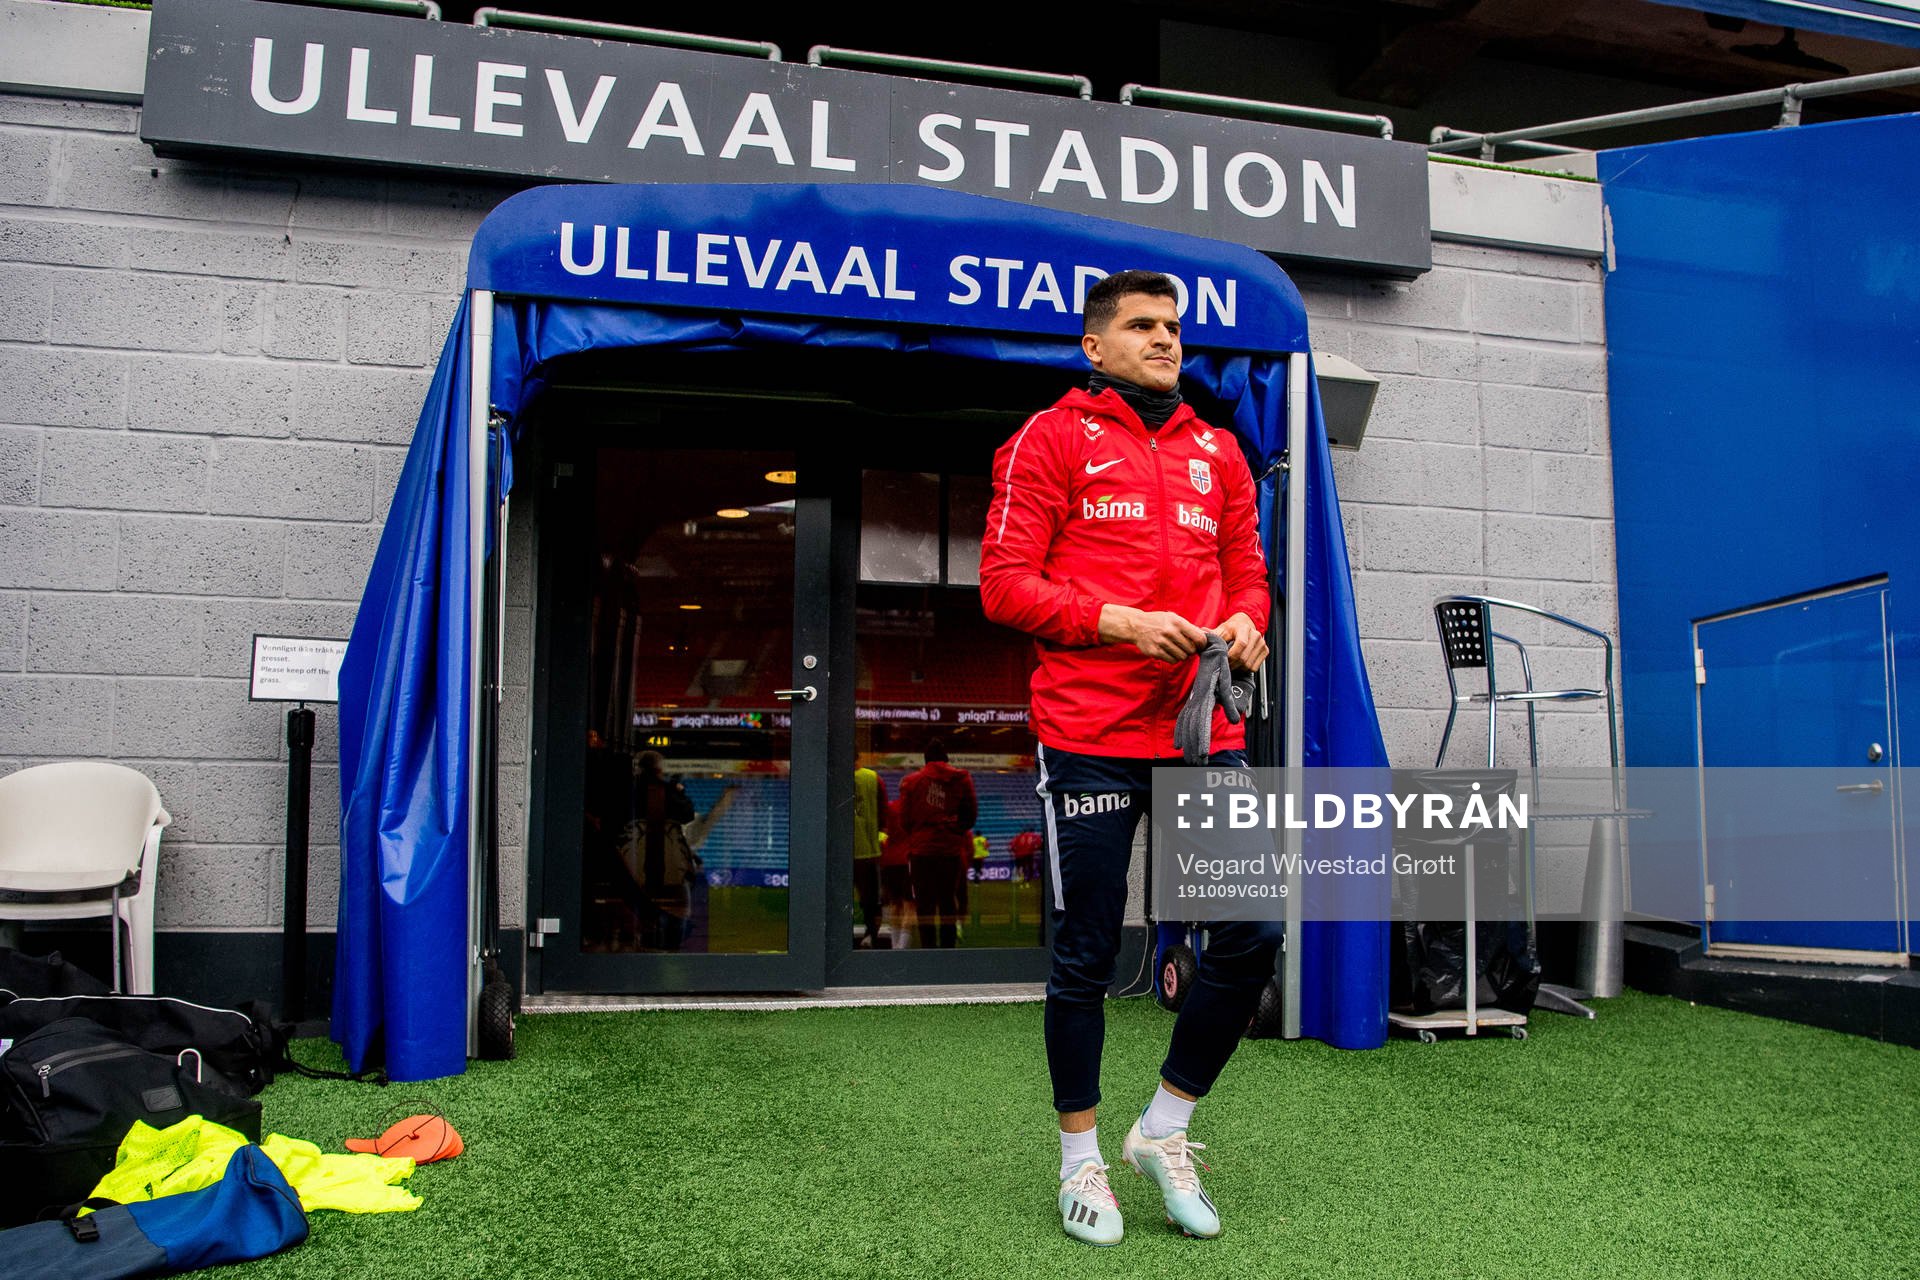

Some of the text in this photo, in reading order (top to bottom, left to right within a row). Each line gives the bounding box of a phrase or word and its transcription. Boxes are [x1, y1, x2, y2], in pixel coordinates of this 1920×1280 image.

[250, 37, 1357, 229] ULLEVAAL STADION
[559, 221, 1237, 328] ULLEVAAL STADN
[1082, 497, 1145, 520] bama
[1178, 503, 1218, 537] bama
[286, 667, 305, 675] keep
[306, 667, 317, 675] off
[1063, 792, 1131, 818] bama
